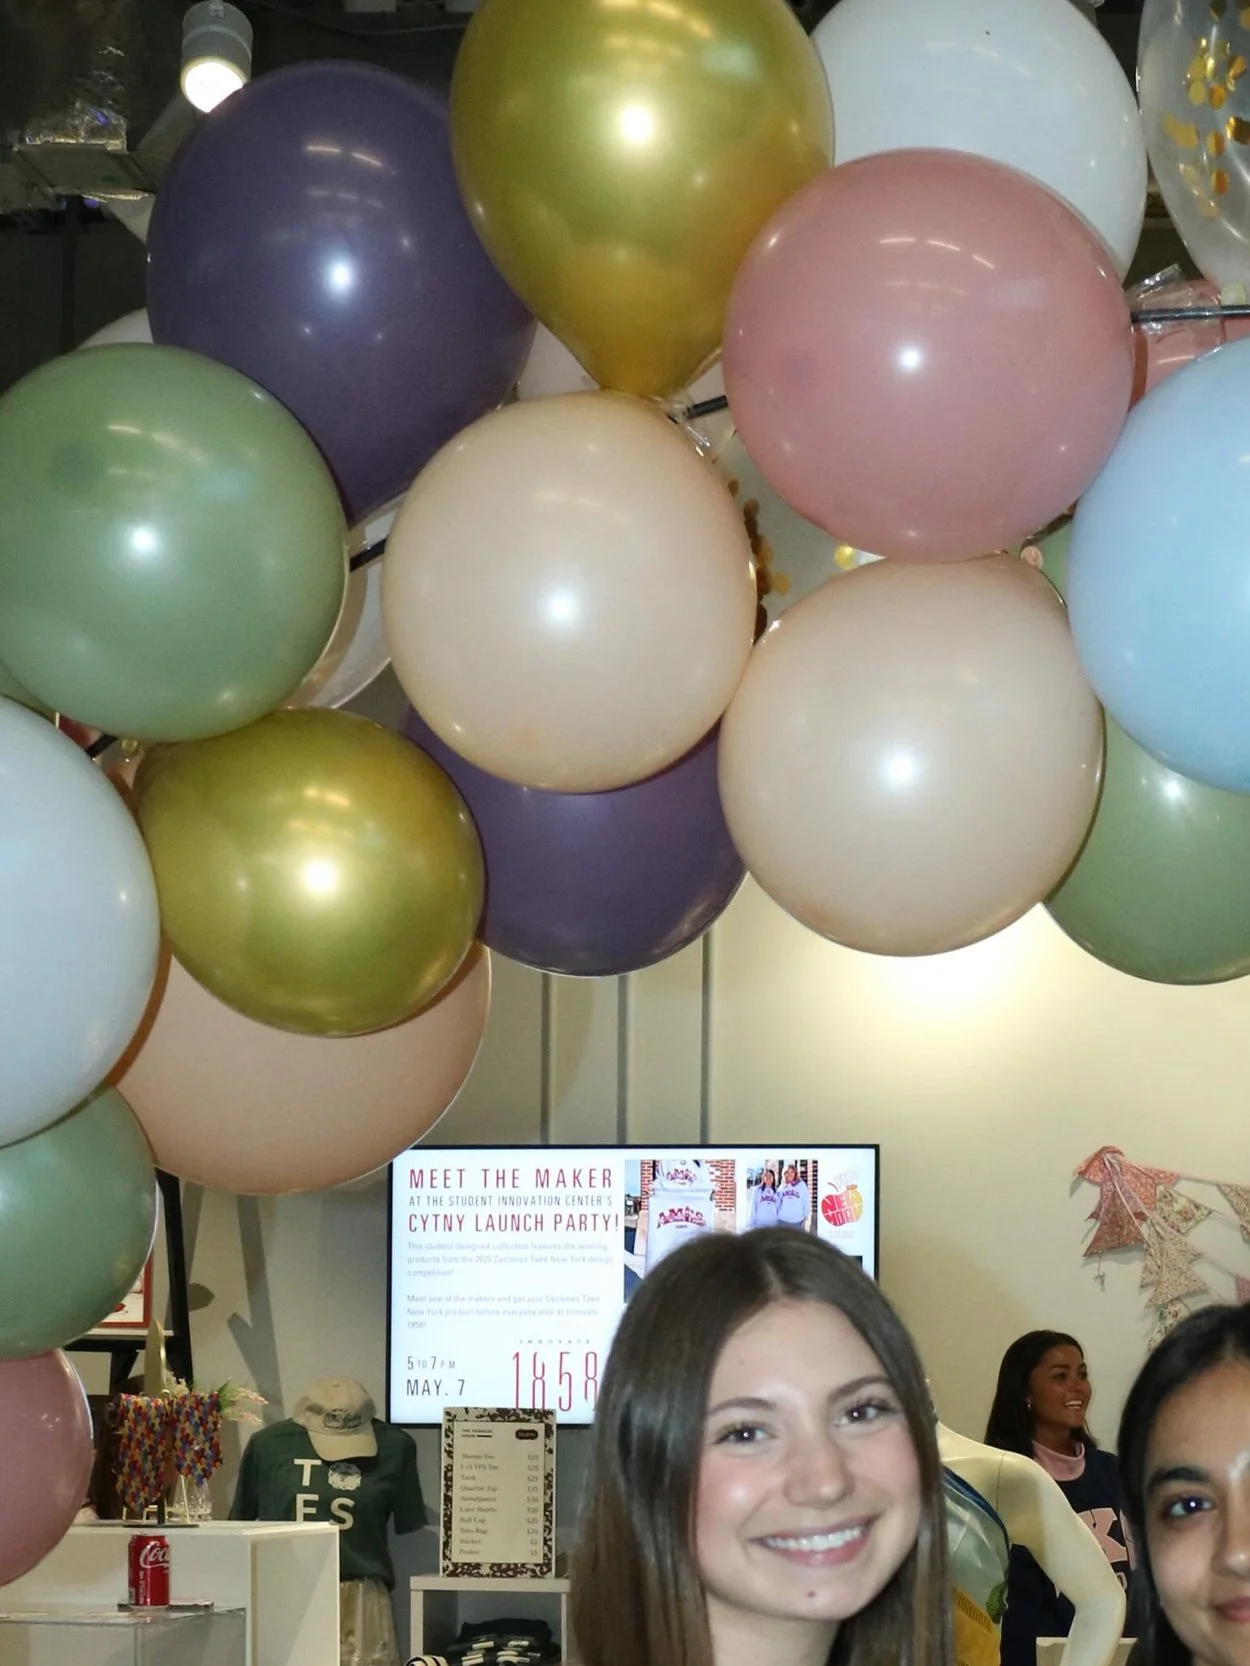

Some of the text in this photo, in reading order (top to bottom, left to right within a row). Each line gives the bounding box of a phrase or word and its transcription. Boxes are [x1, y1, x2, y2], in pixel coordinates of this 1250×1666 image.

[409, 1168, 613, 1189] MEET THE MAKER
[408, 1195, 613, 1207] AT THE STUDENT INNOVATION CENTER'S
[409, 1213, 619, 1232] CYTNY LAUNCH PARTY!
[407, 1355, 414, 1370] 5
[417, 1360, 427, 1369] TO
[430, 1355, 437, 1370] 7
[406, 1378, 465, 1397] MAY. 7
[512, 1351, 598, 1412] 1858
[294, 1458, 322, 1487] T
